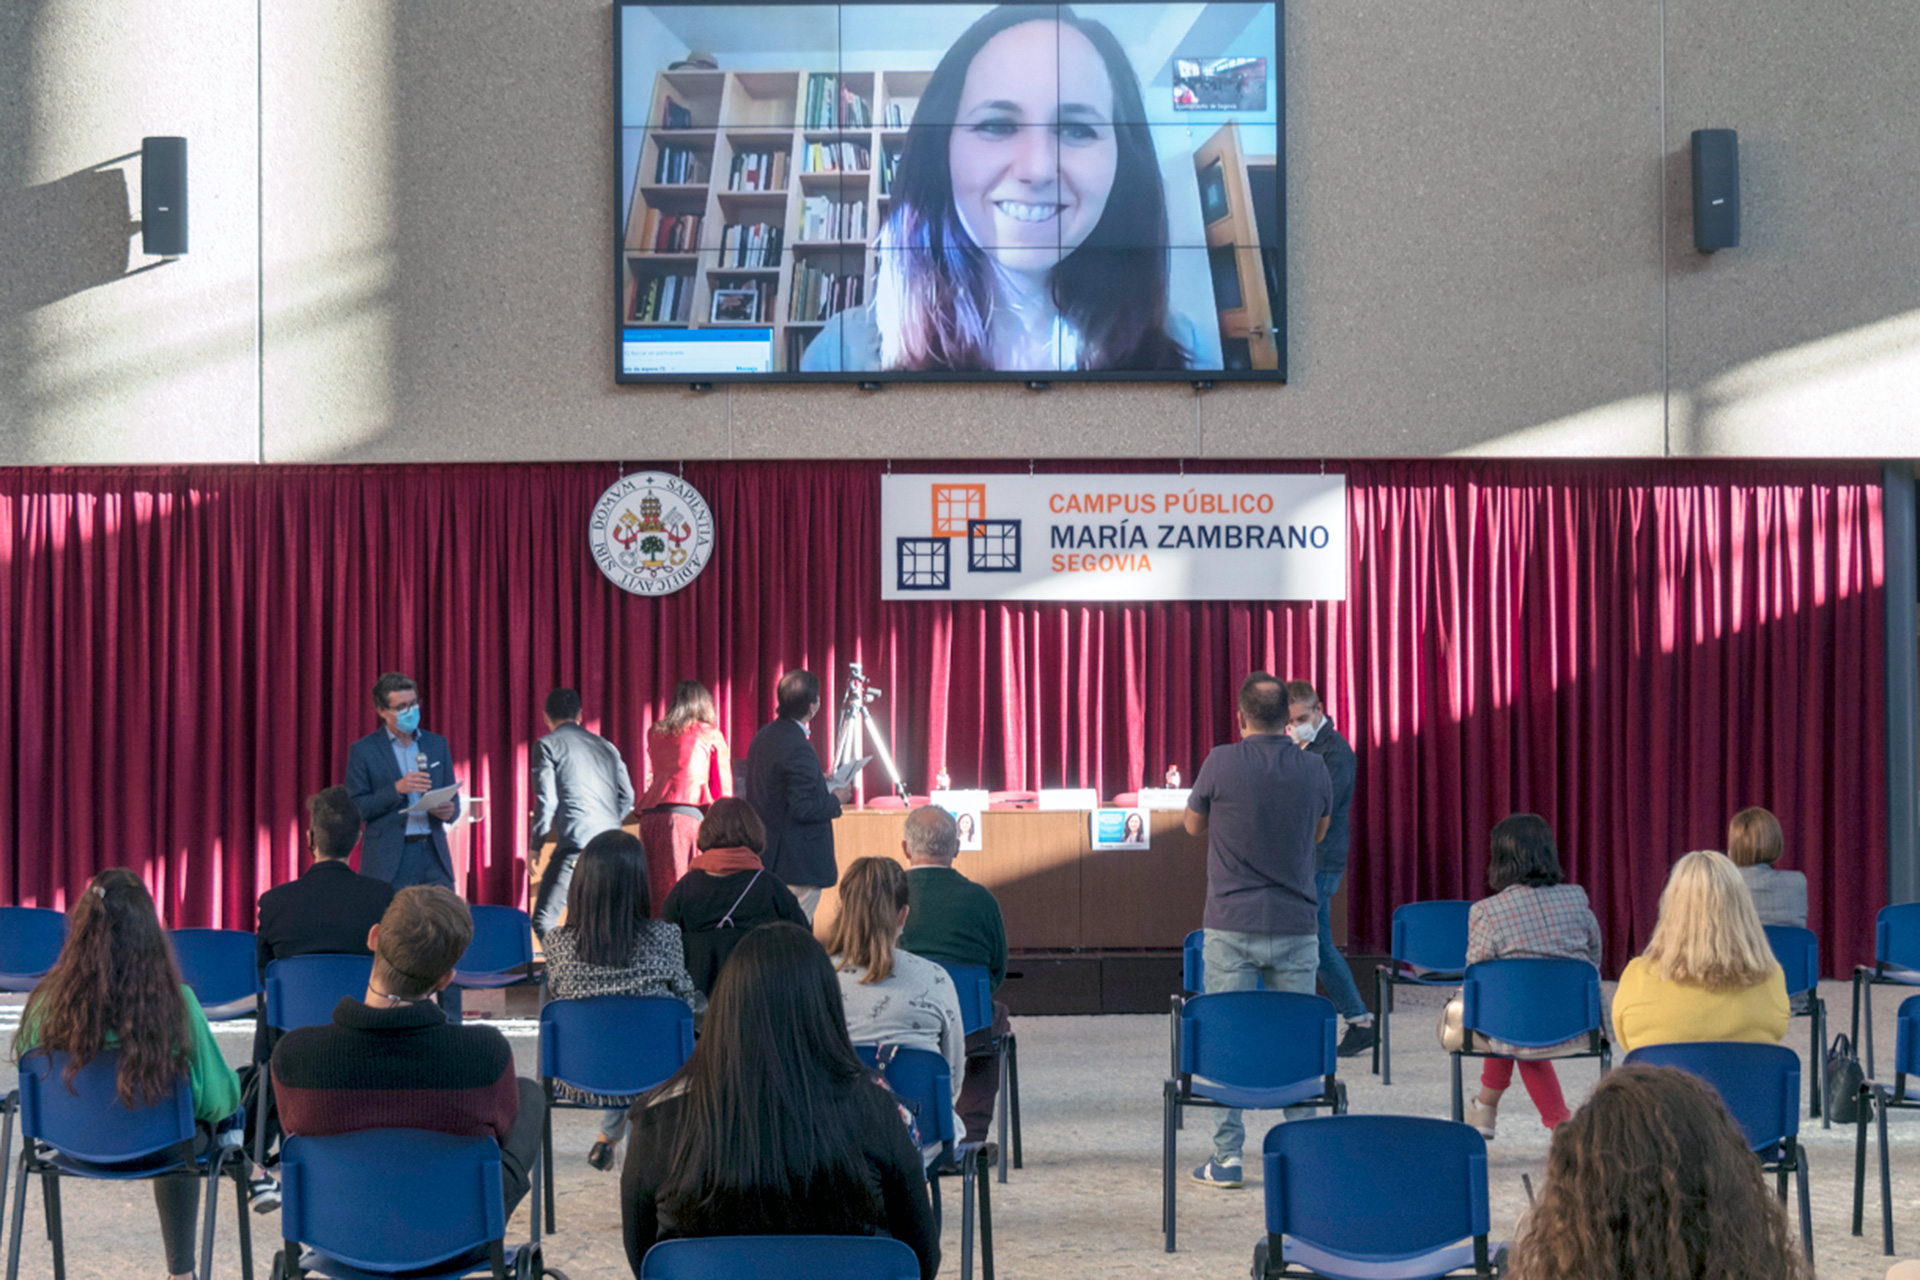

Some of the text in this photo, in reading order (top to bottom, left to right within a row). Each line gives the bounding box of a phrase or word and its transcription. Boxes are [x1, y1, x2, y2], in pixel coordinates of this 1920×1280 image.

[592, 480, 636, 530] DOMVM
[666, 478, 711, 546] SAPIENTIA
[1049, 488, 1274, 514] CAMPUS PÚBLICO
[1050, 519, 1329, 549] MARÍA ZAMBRANO
[594, 542, 615, 571] SIBI
[1051, 553, 1152, 572] SEGOVIA
